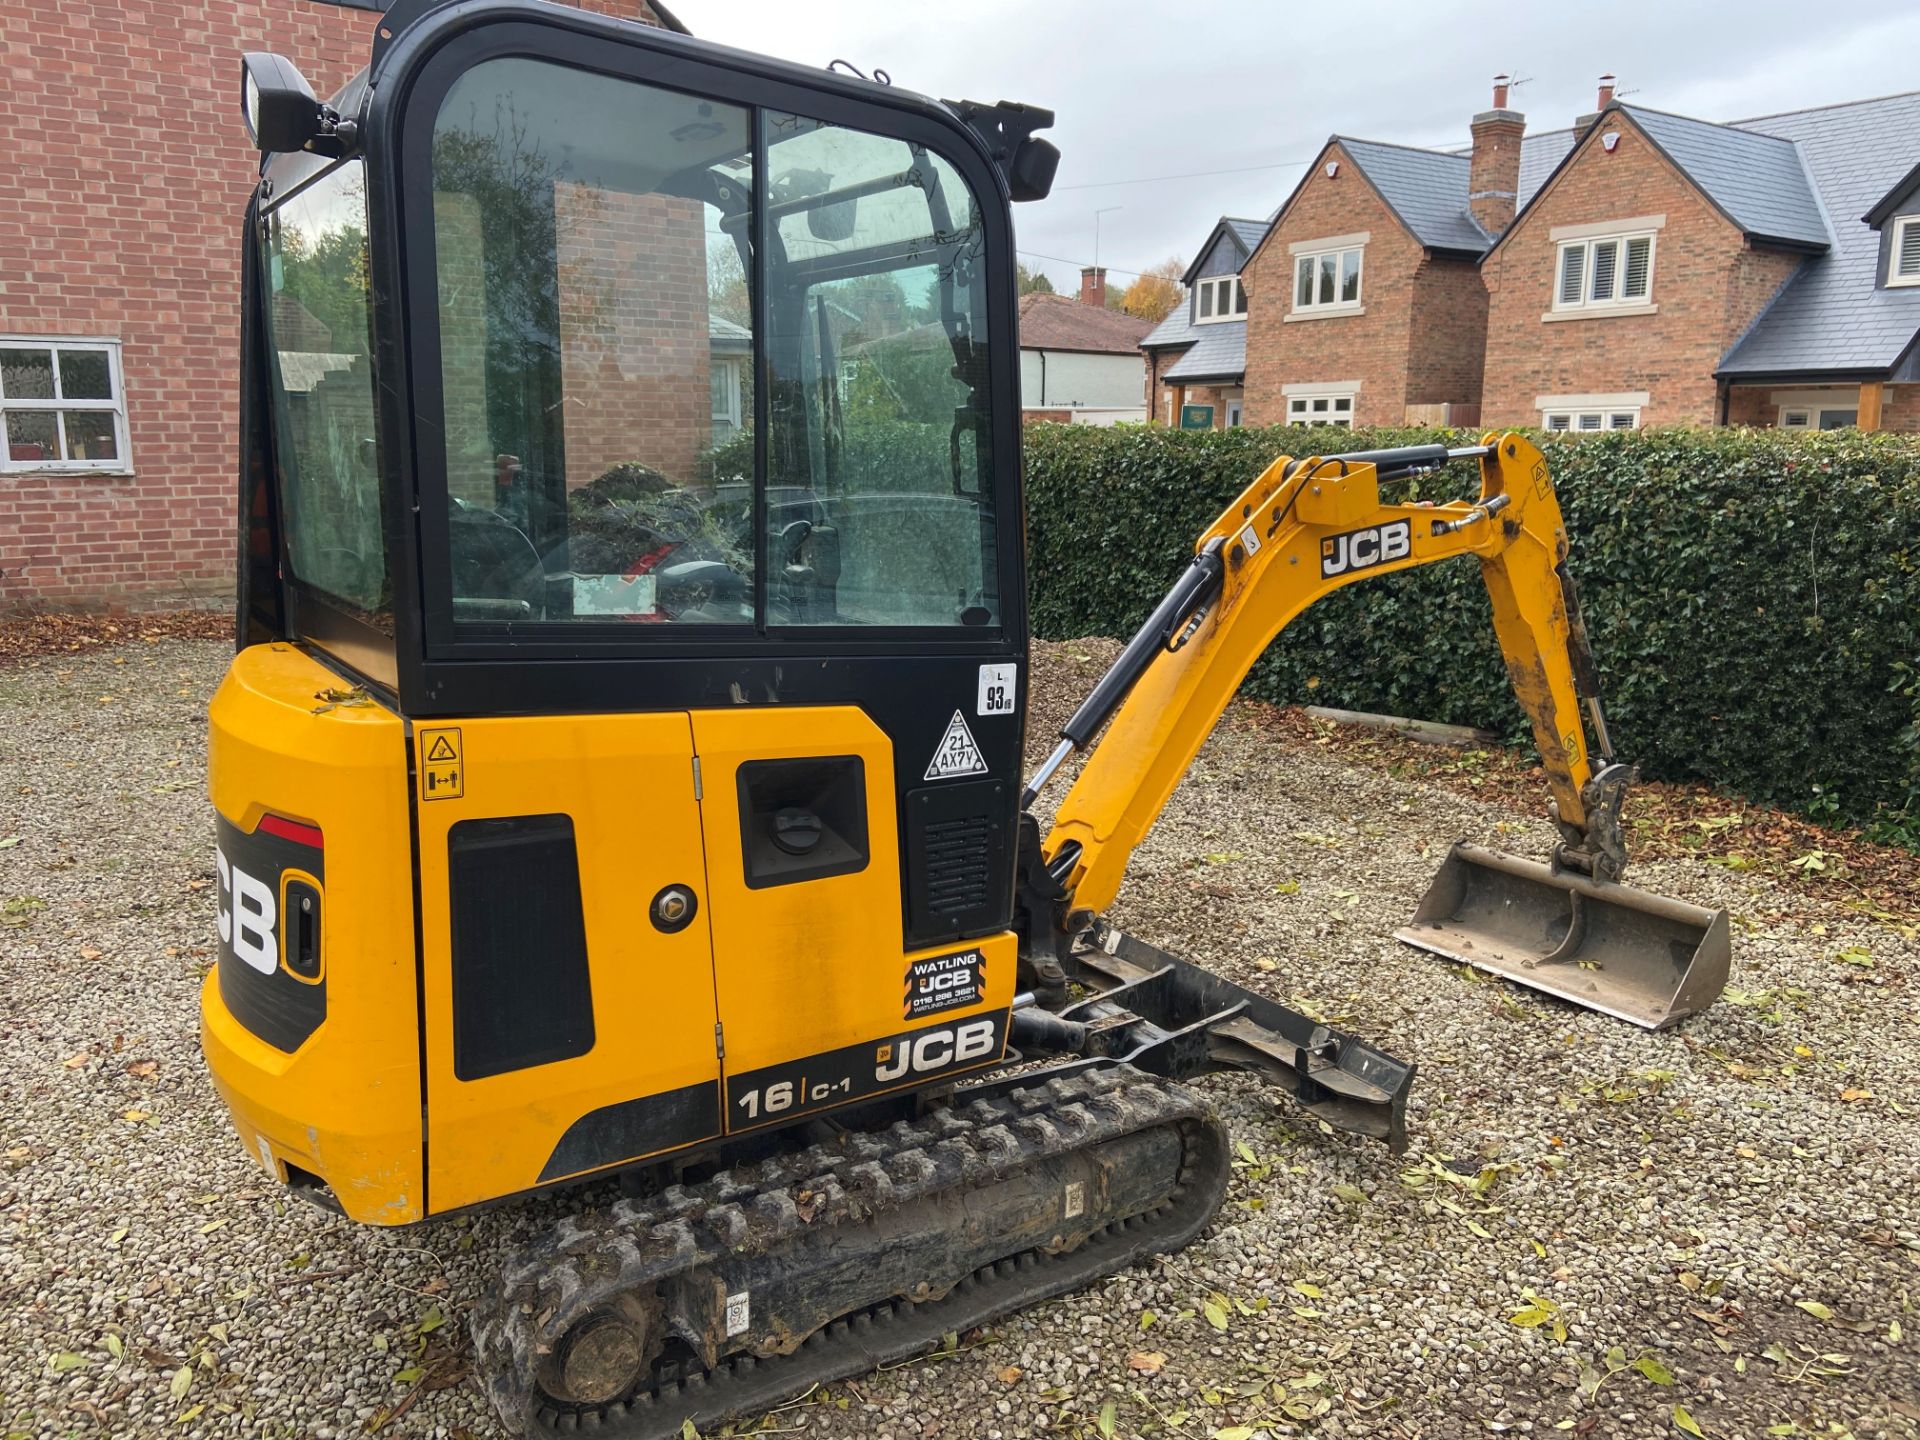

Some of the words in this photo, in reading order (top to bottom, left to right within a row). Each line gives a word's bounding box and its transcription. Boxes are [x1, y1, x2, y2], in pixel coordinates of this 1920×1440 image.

[1323, 522, 1410, 575] JCB
[997, 672, 1003, 681] L
[950, 735, 965, 750] 21
[914, 954, 977, 976] WATLING
[919, 969, 971, 994] JCB
[913, 996, 933, 1007] 0116
[875, 1020, 995, 1082] JCB
[738, 1081, 793, 1118] 16
[811, 1077, 851, 1101] C-1
